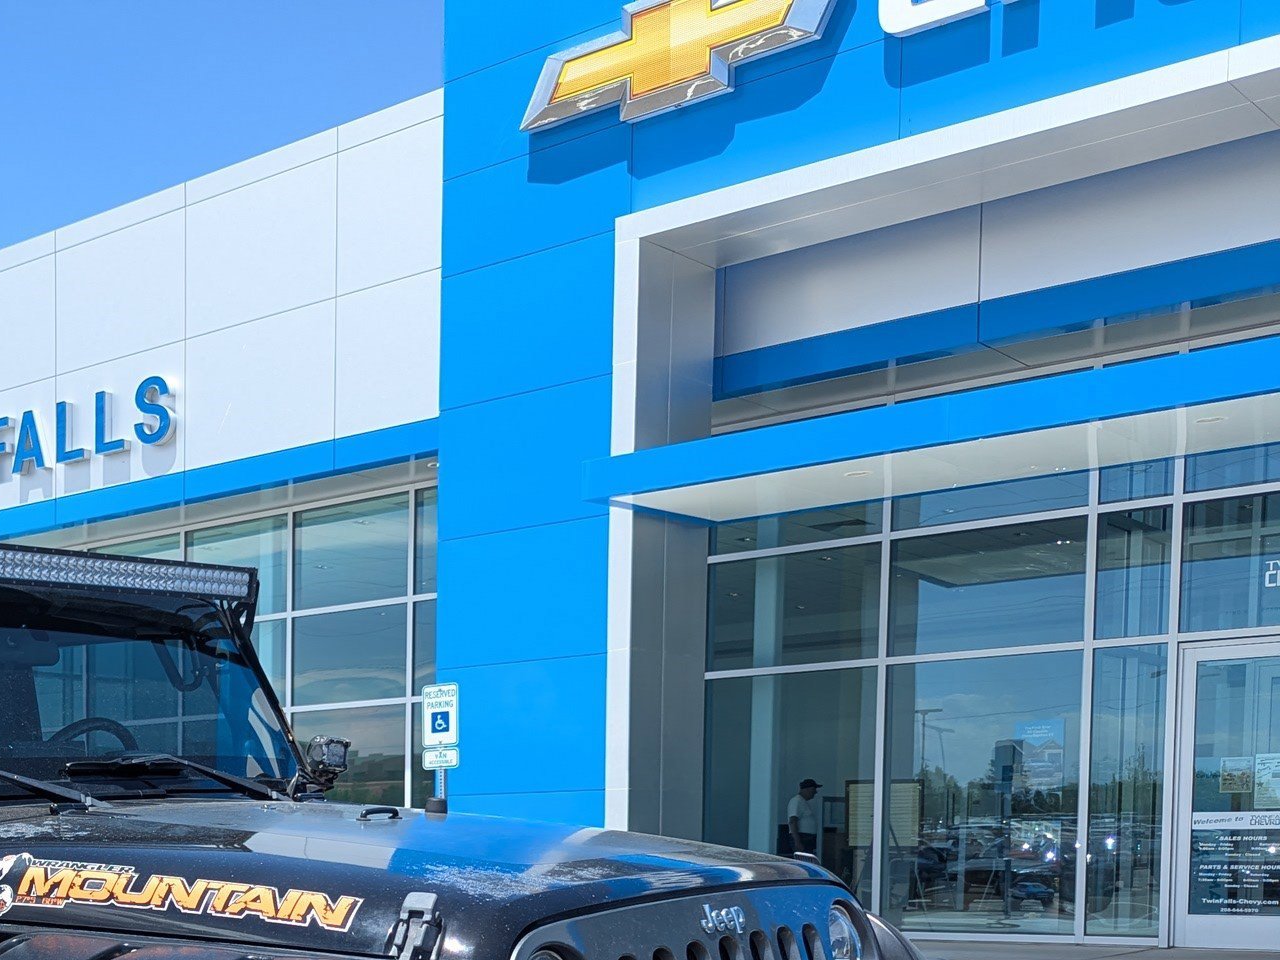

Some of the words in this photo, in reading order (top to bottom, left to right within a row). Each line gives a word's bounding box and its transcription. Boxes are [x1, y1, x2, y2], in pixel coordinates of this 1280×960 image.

[425, 688, 456, 699] RESERVED
[426, 699, 454, 710] PARKING
[1193, 817, 1232, 826] Welcome
[31, 859, 134, 874] WRANGLER
[16, 866, 362, 931] MOUNTAIN
[699, 903, 746, 934] Jeep
